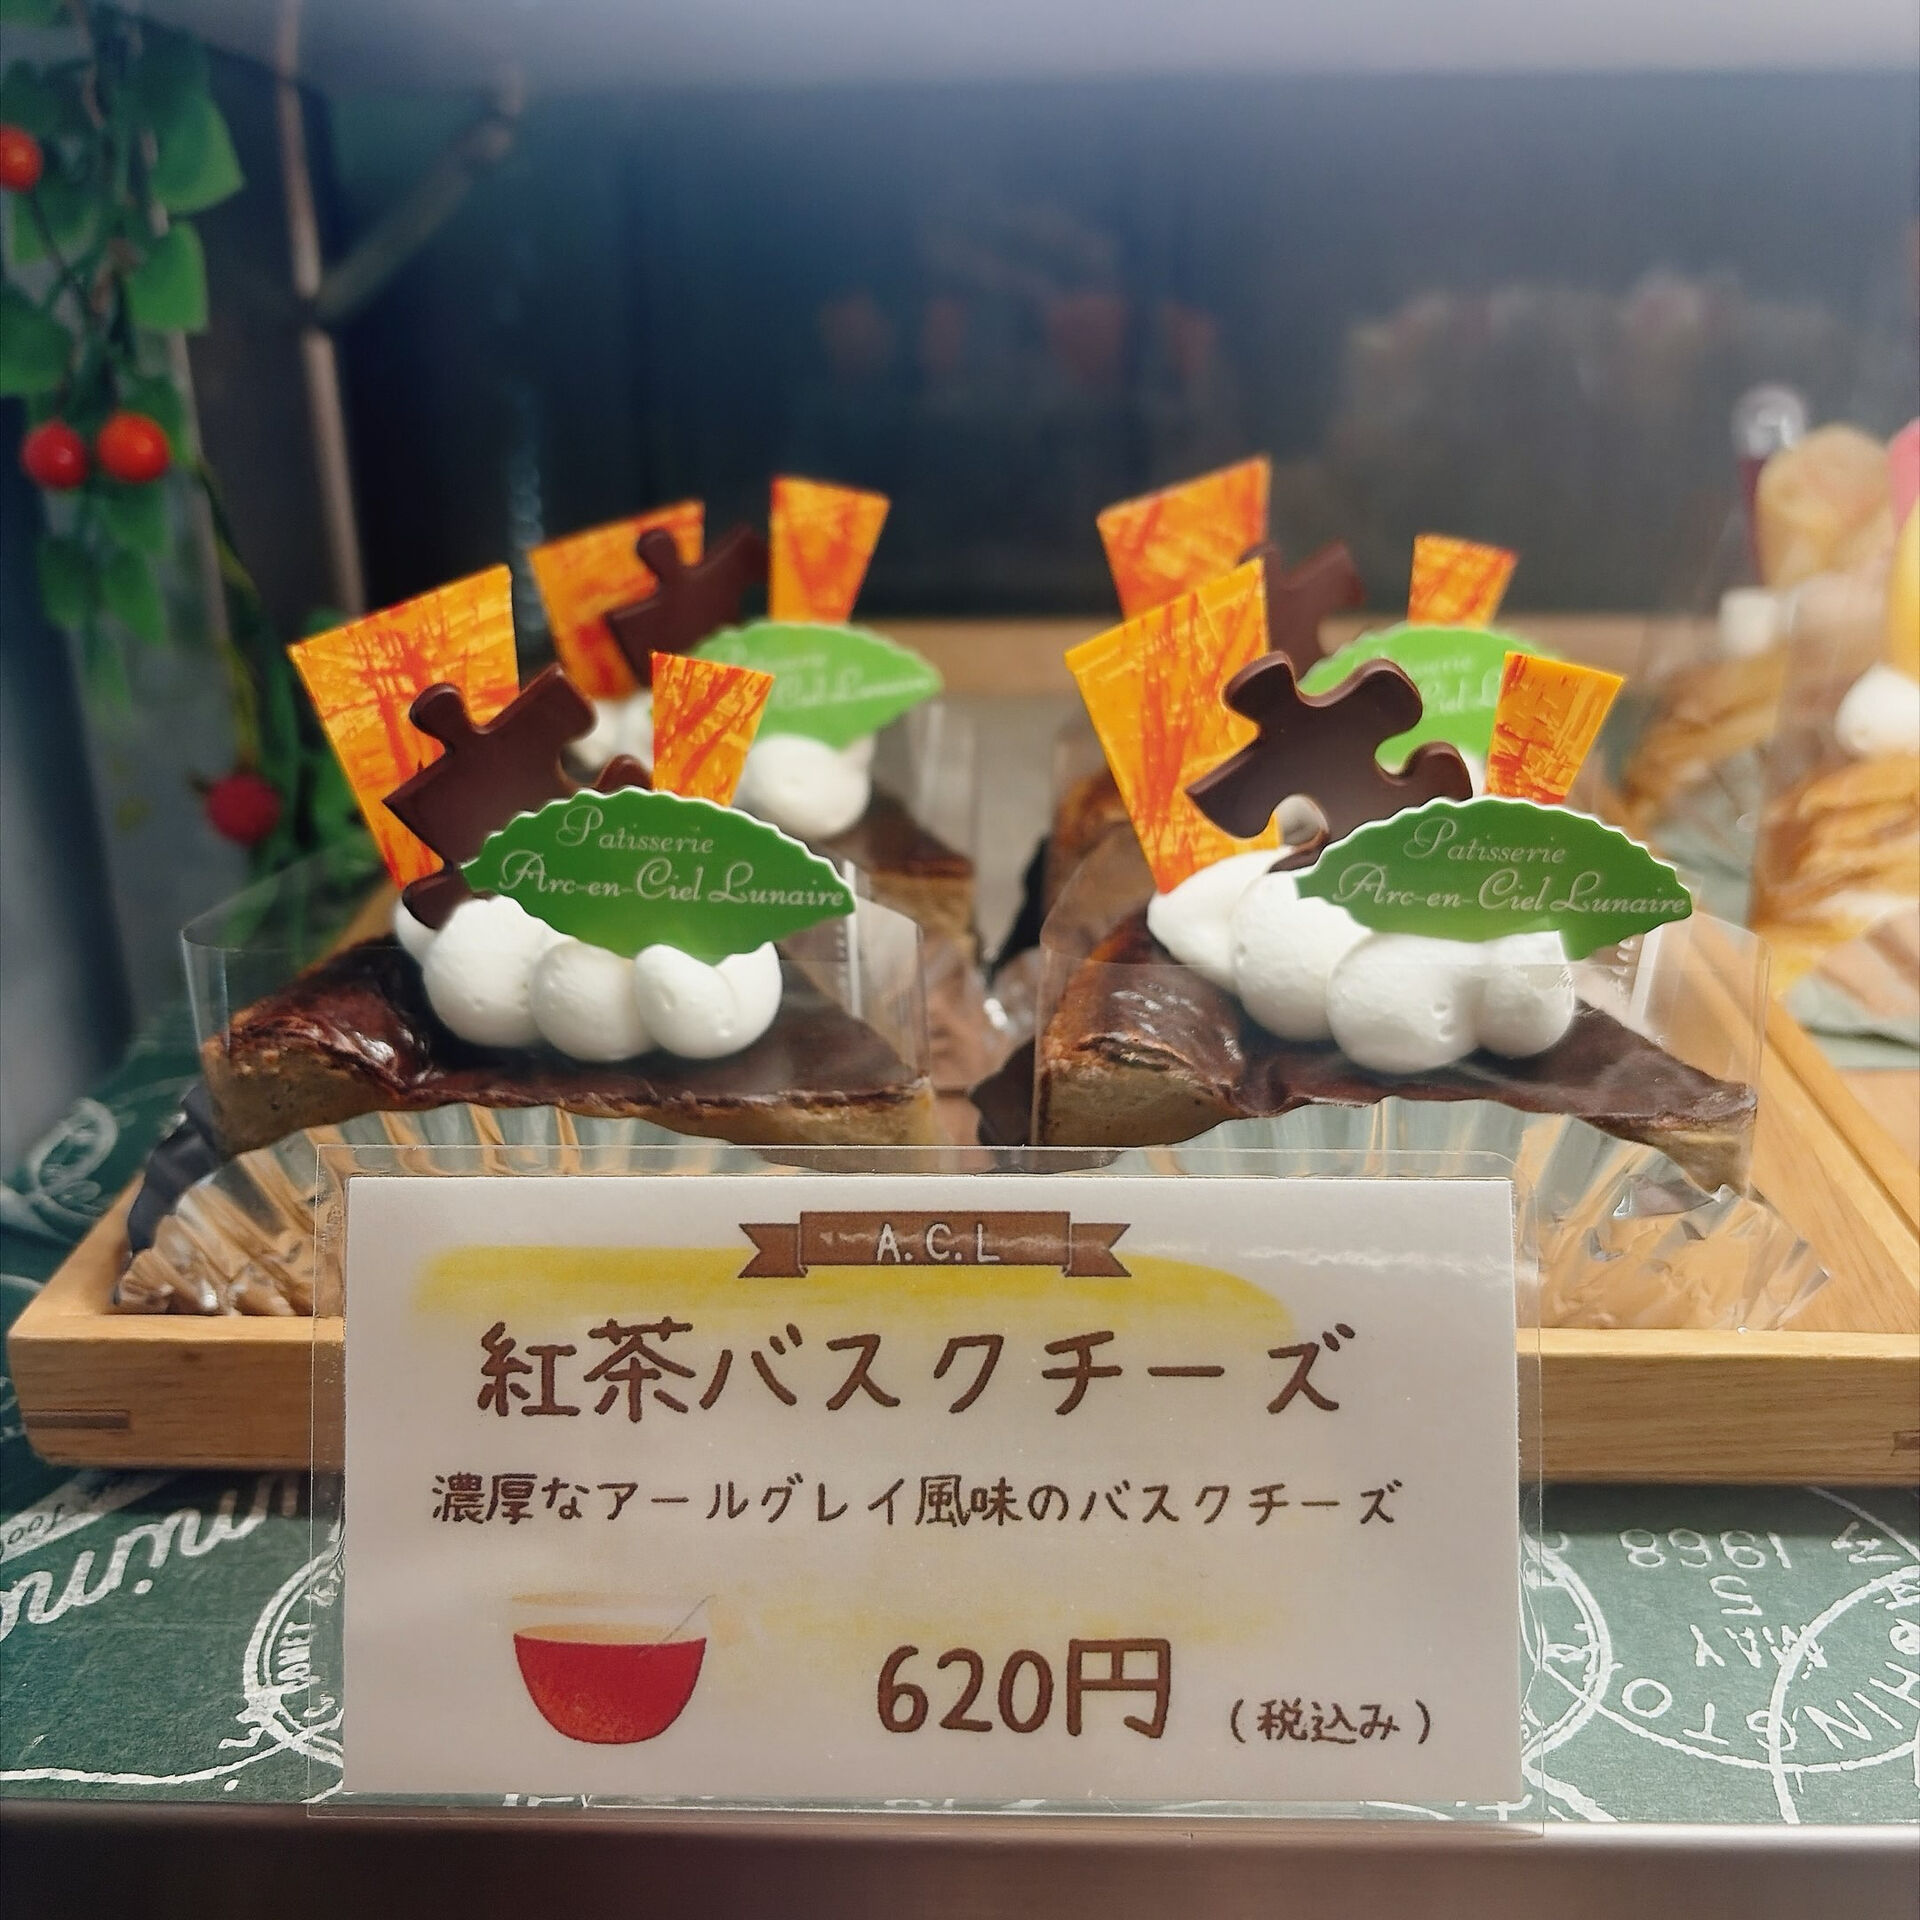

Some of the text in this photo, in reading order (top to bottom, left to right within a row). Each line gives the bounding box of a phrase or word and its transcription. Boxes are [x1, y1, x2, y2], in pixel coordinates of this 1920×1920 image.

[556, 805, 714, 854] Patisserie
[1403, 817, 1566, 864] Patisserie
[499, 850, 844, 907] Arc-en-Ciel Lunaire
[1332, 862, 1686, 914] Arc-en-Ciel Lunaire
[876, 1223, 1000, 1262] A.C.L
[477, 1316, 1357, 1424] 紅茶バスクチーズ
[432, 1471, 1402, 1528] 濃厚なアールグレイ風味のバスクチーズ
[877, 1638, 1172, 1740] 620円
